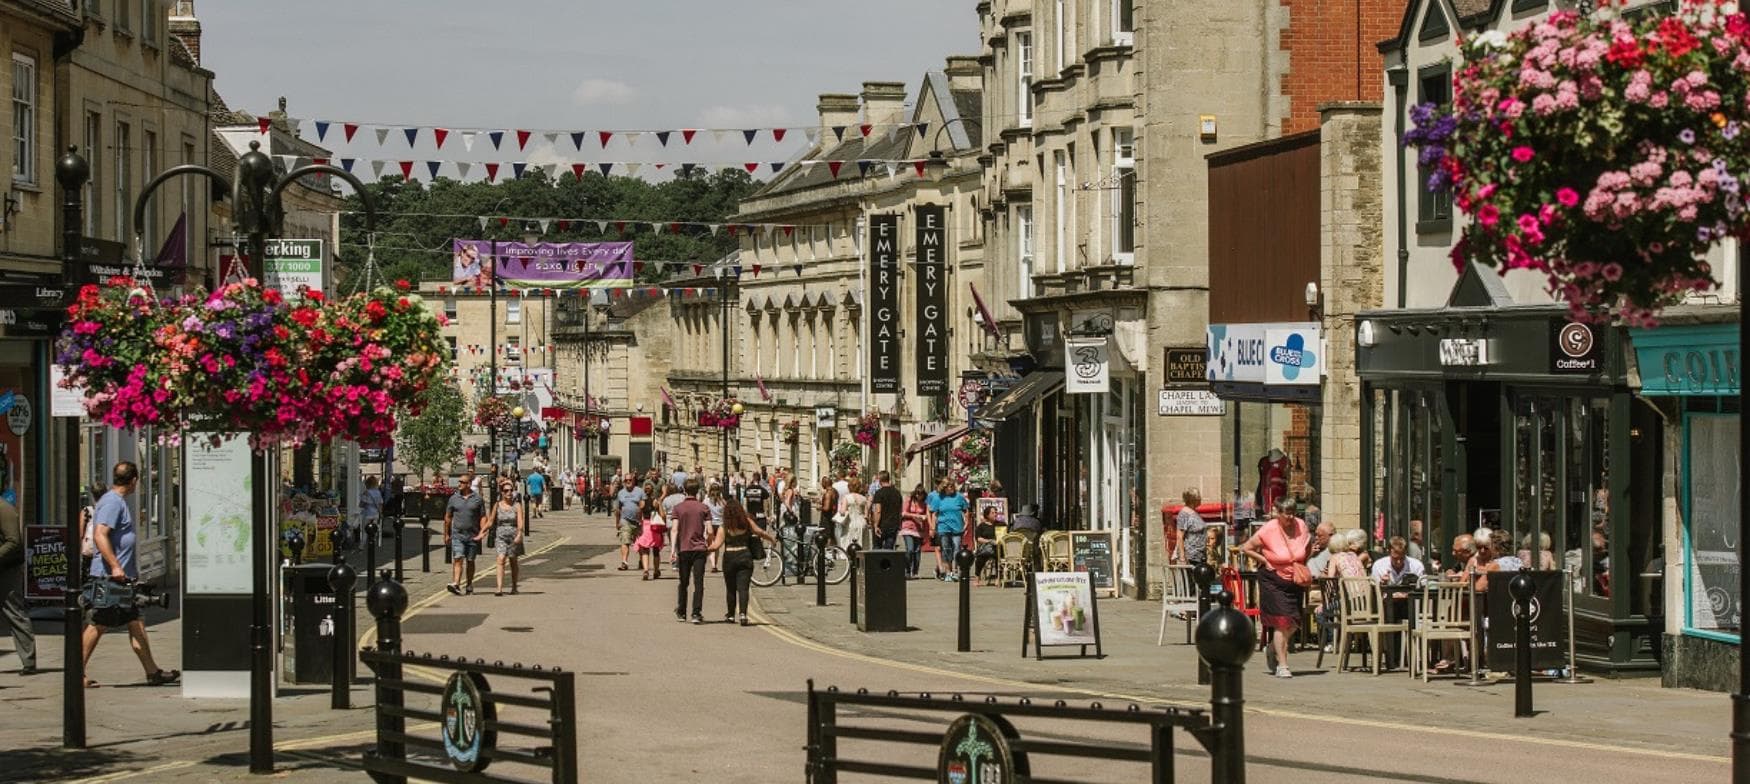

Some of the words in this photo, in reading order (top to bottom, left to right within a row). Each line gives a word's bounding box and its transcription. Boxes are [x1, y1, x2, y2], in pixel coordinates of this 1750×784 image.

[505, 247, 554, 256] Improving
[557, 247, 578, 255] lives
[582, 247, 609, 256] Every
[923, 214, 938, 297] EMERY
[877, 223, 891, 299] EMERY
[36, 287, 64, 299] Library
[878, 308, 891, 369] GATE
[924, 305, 938, 370] GATE
[1180, 354, 1201, 363] OLD
[1275, 355, 1301, 366] CROSS
[1170, 362, 1205, 371] BAPTIS
[1170, 370, 1204, 379] CHAPE
[1160, 405, 1192, 413] CHAPEL
[33, 553, 68, 566] MEGA
[33, 564, 68, 577] DEALS
